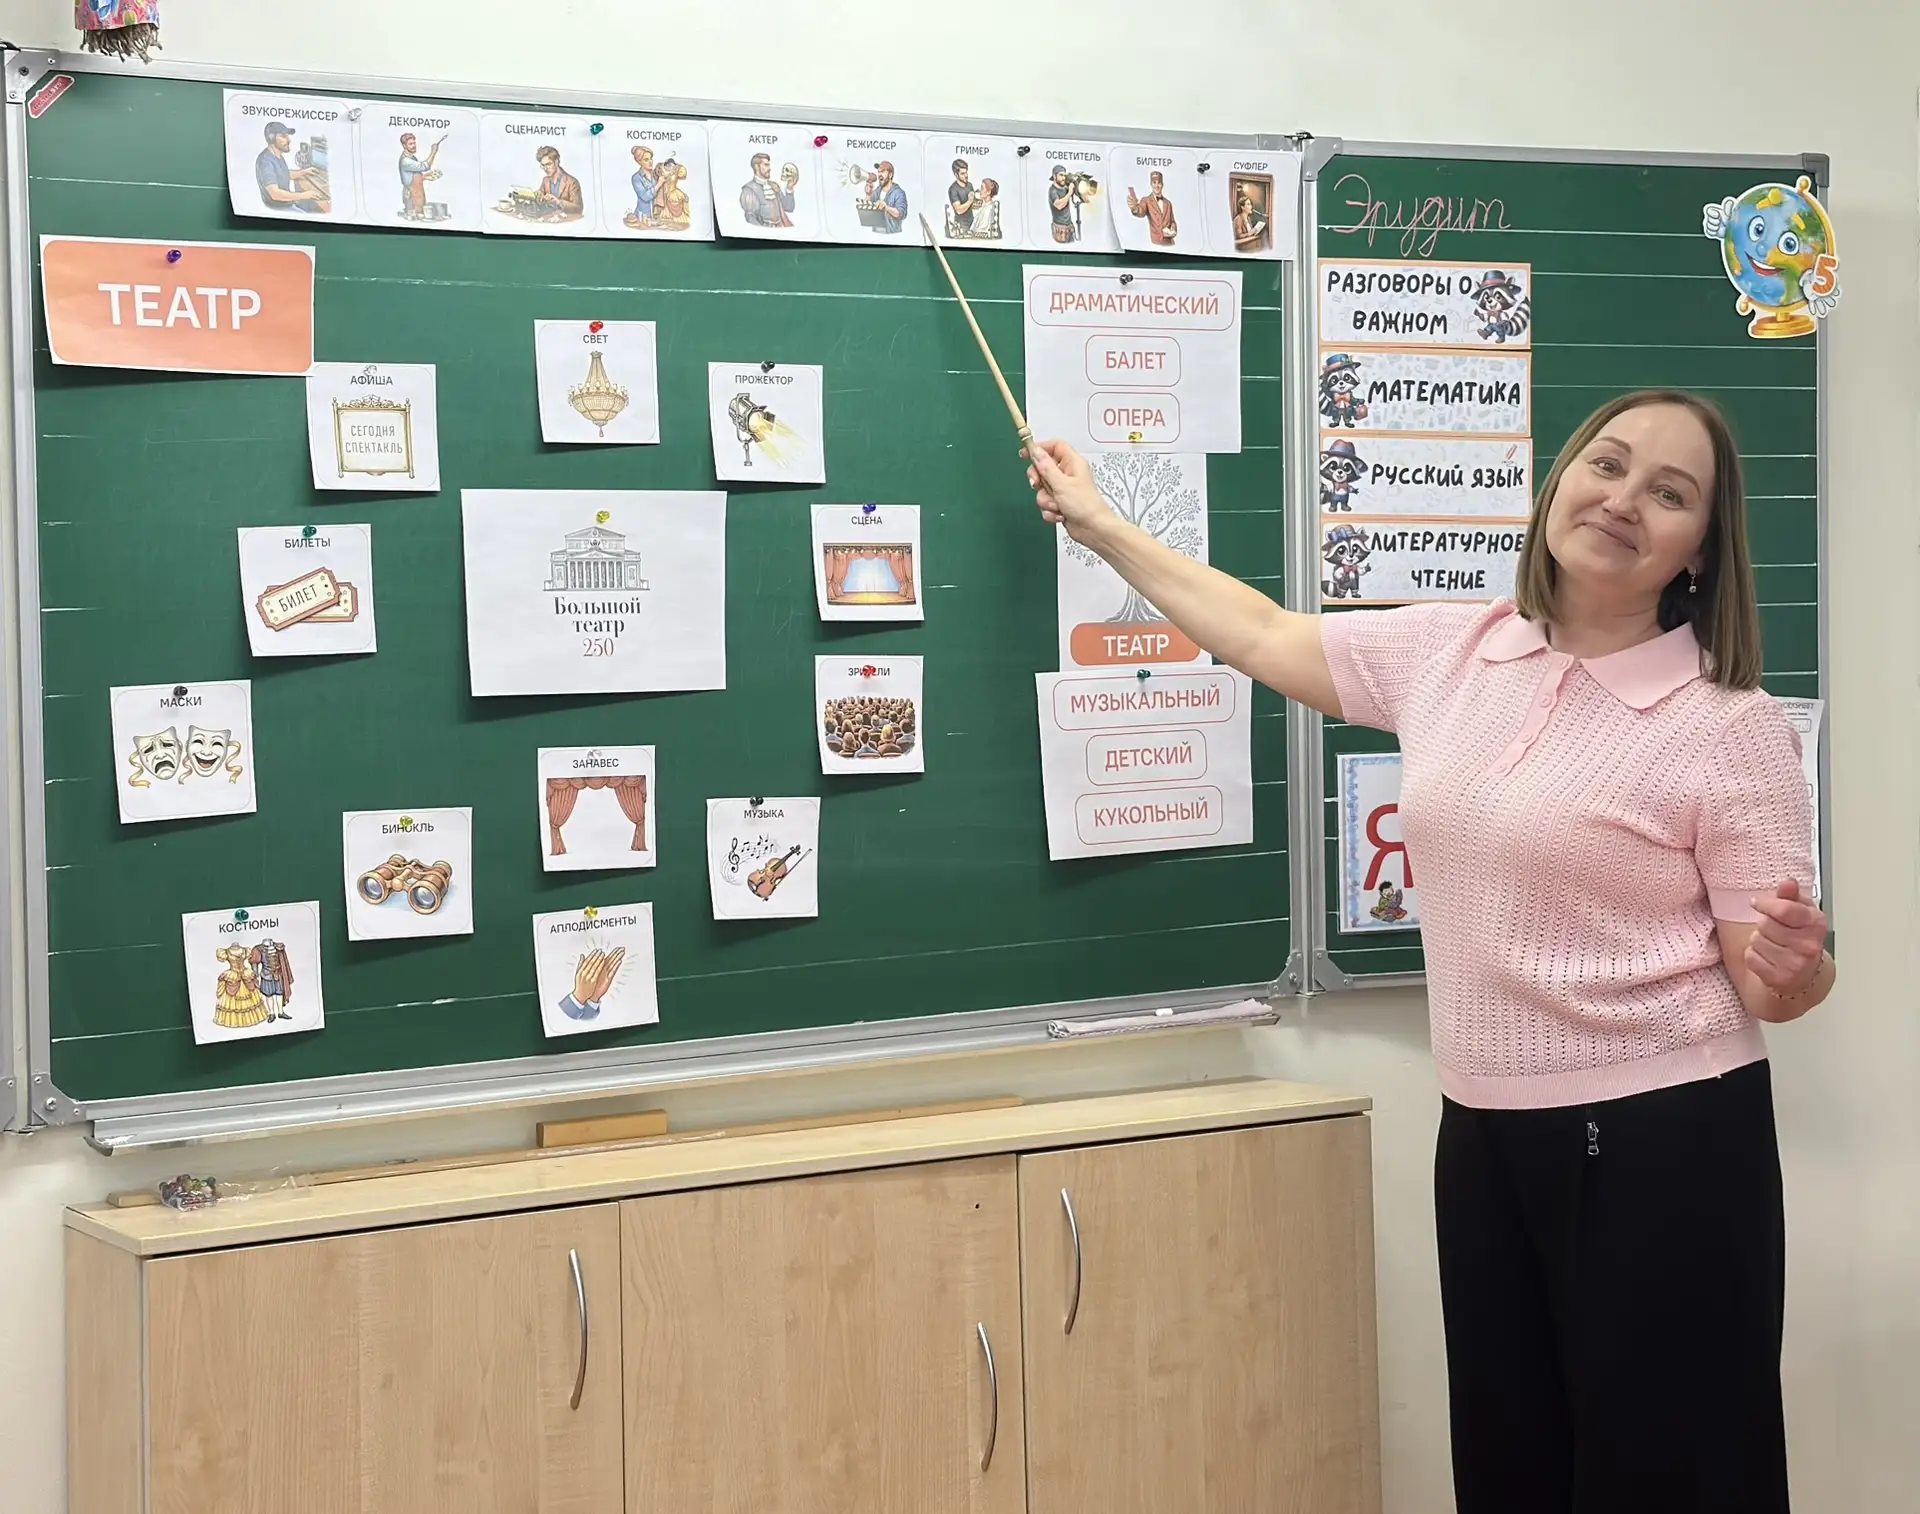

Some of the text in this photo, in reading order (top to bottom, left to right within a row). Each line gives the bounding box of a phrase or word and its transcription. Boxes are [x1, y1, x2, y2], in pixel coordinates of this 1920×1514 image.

[241, 105, 338, 122] ЗВУКОРЕЖИССЕР
[388, 115, 451, 129] ДЕКОРАТОР
[505, 124, 567, 137] СЦЕНАРИСТ
[626, 130, 682, 142] КОСТЮМЕР
[748, 134, 778, 145] АКТЕР
[846, 139, 897, 151] РЕЖИССЕР
[955, 145, 990, 156] ГРИМЕР
[1045, 150, 1101, 162] ОСВЕТИТЕЛЬ
[1136, 156, 1173, 168] БИЛЕТЕР
[1233, 160, 1269, 172] СУФЛЕР
[1332, 173, 1512, 258] Эрудит
[1327, 270, 1473, 296] РАЗГОВОРЫ О
[1813, 255, 1838, 295] 5
[97, 282, 263, 331] ТЕАТР
[1049, 291, 1220, 315] ДРАМАТИЧЕСКИЙ
[1352, 310, 1448, 335] ВАЖНОМ
[582, 334, 609, 344] СВЕТ
[1105, 350, 1167, 370] БАЛЕТ
[350, 375, 394, 386] АФИША
[734, 374, 794, 386] ПРОЖЕКТОР
[1367, 379, 1521, 405] МАТЕМАТИКА
[1103, 408, 1166, 427] ОПЕРА
[350, 425, 396, 438] СЕГОДНЯ
[344, 441, 404, 454] СПЕКТАКЛЬ
[1371, 464, 1525, 489] РУССКИЙ ЯЗЫК
[851, 515, 883, 527] СЦЕНА
[284, 537, 331, 549] БИЛЕТЫ
[1371, 531, 1525, 555] ЛИТЕРАТУРНОЕ
[1411, 569, 1486, 591] ЧТЕНИЕ
[278, 583, 319, 613] БИЛЕТ
[554, 596, 642, 616] Большой
[571, 618, 626, 638] театр
[582, 638, 615, 657] 250
[1102, 633, 1170, 658] ТЕАТР
[847, 666, 891, 677] ЗРЛИ
[159, 696, 203, 709] МАСКИ
[1070, 683, 1221, 714] МУЗЫКАЛЬНЫЙ
[572, 758, 620, 769] ЗАНАВЕС
[1104, 741, 1193, 772] ДЕТСКИЙ
[743, 808, 785, 820] МУЗЫКА
[1093, 796, 1209, 828] КУКОЛЬНЫЙ
[381, 821, 435, 835] БИНОКЛЬ
[218, 917, 280, 934] КОСТЮМЫ
[549, 915, 638, 935] АПЛОДИСМЕНТЫ
